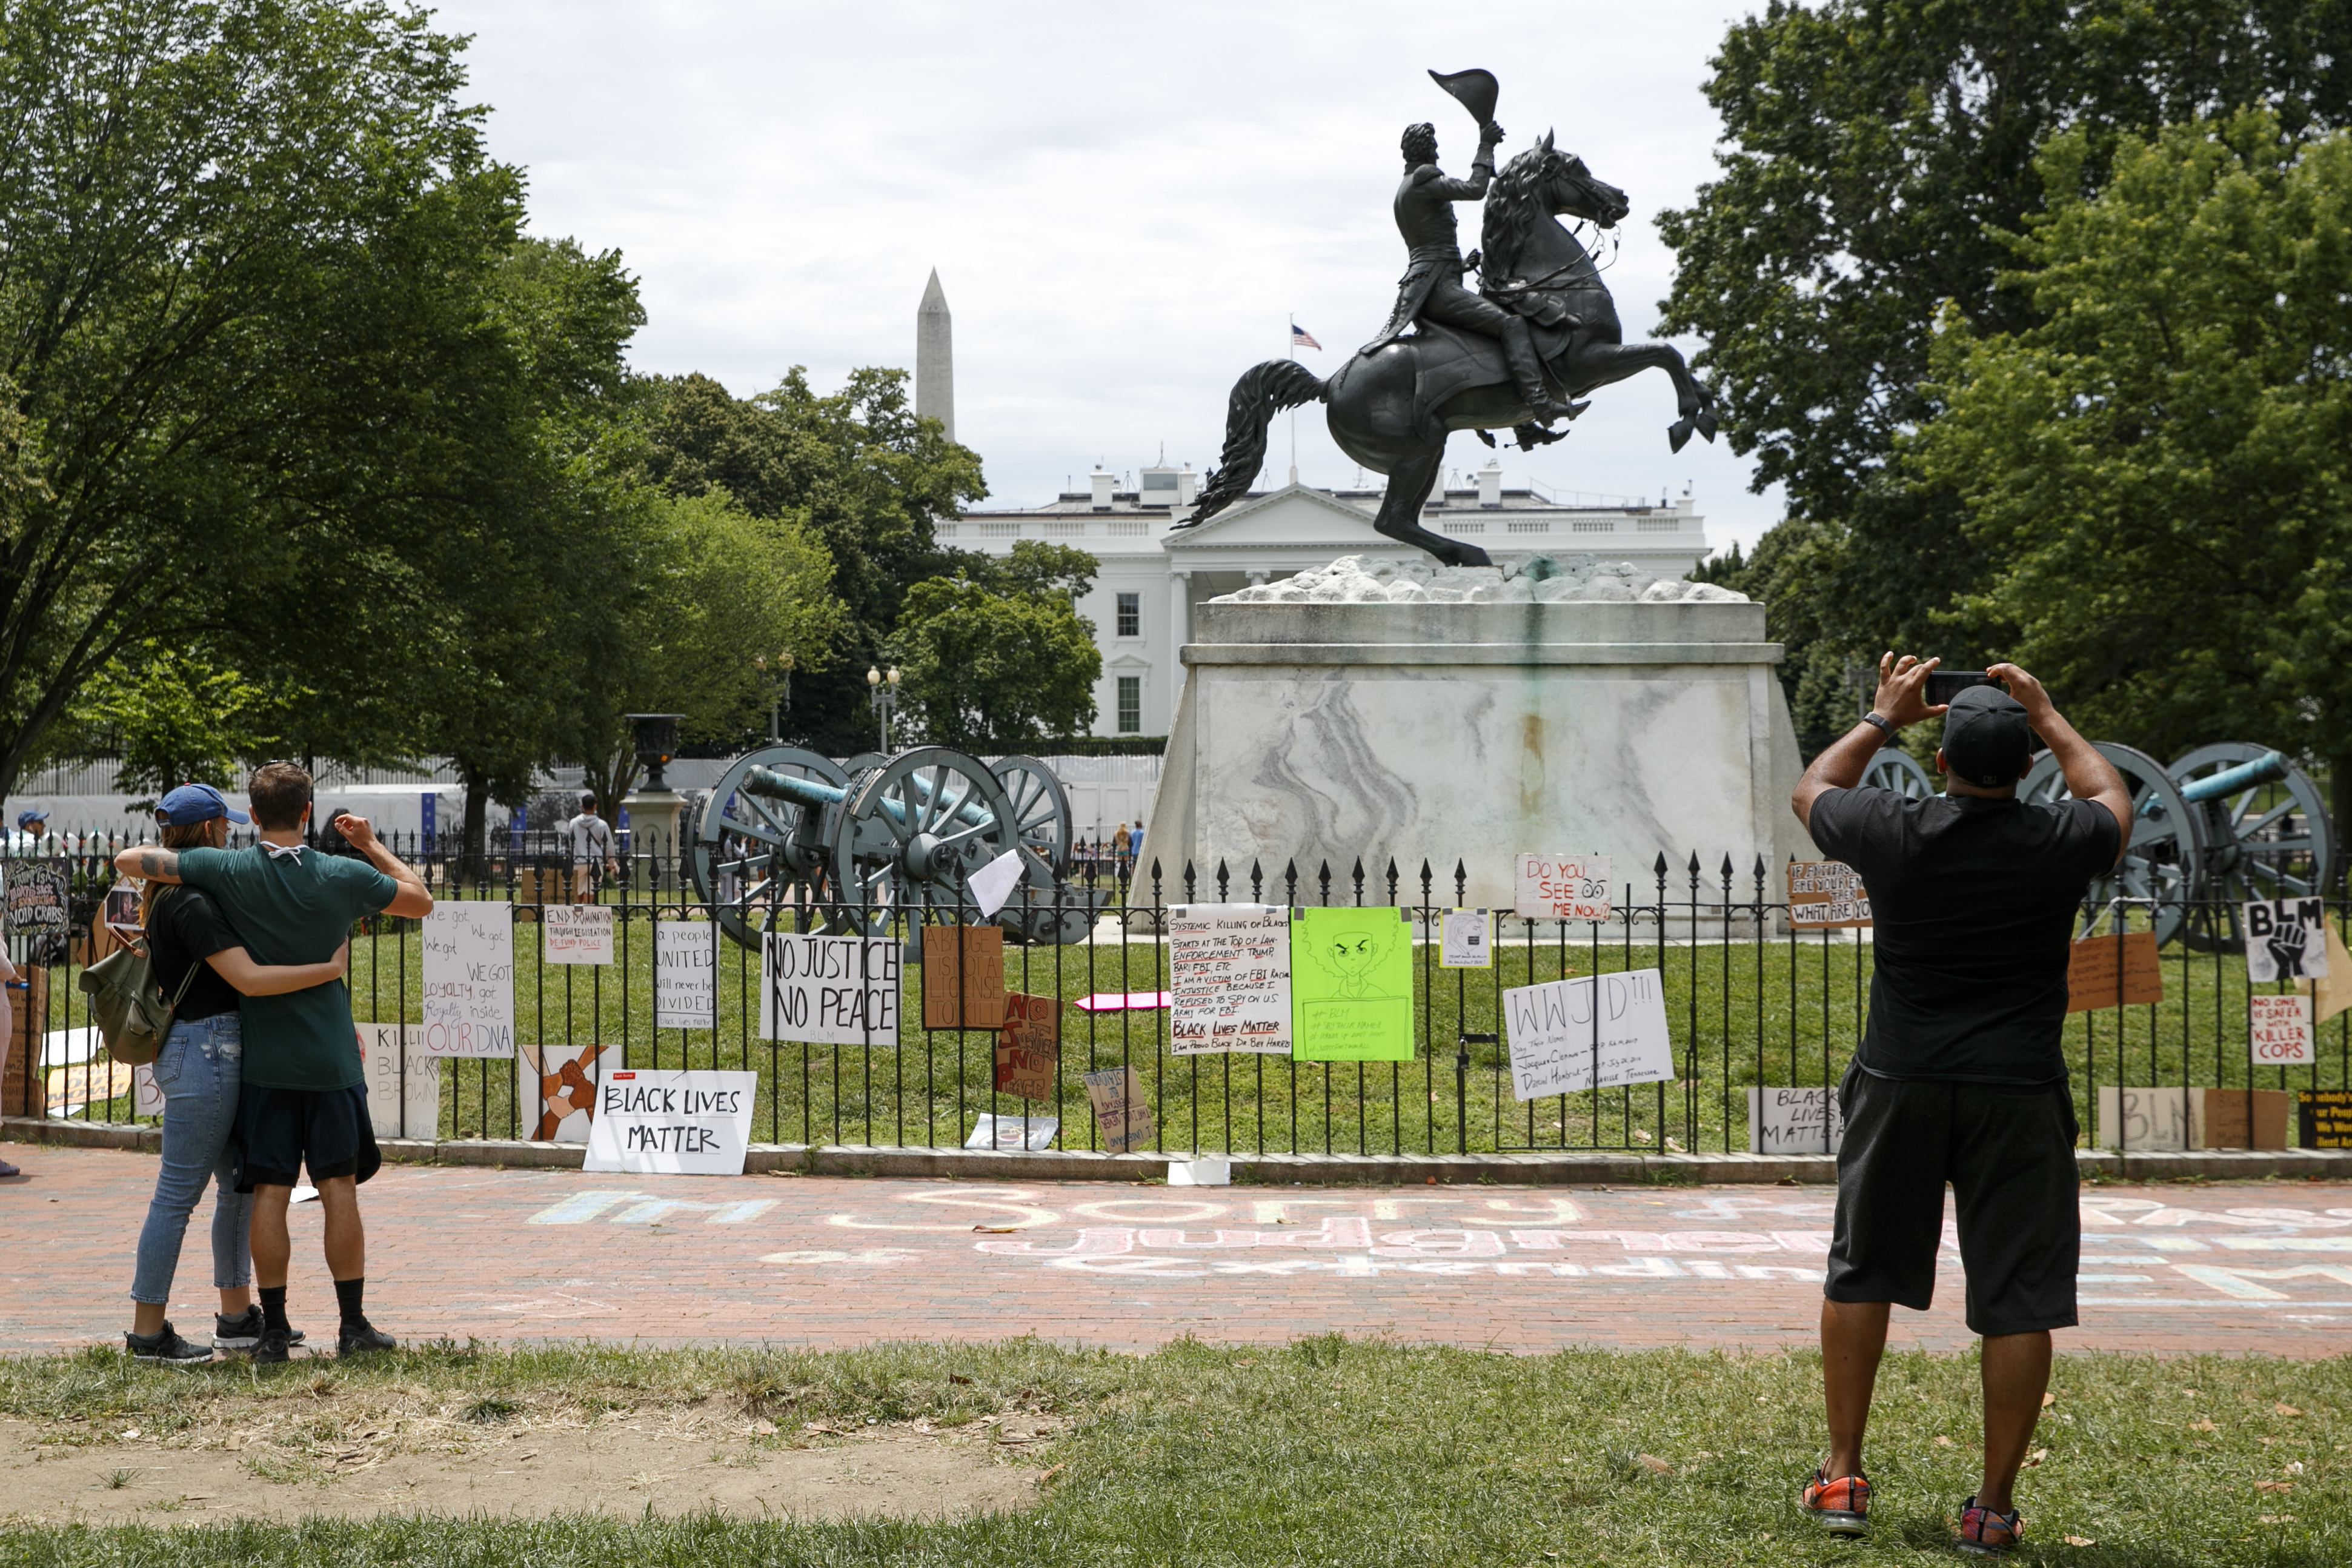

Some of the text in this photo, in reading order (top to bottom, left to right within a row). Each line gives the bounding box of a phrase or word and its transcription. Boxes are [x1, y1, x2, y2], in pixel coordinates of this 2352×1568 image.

[1528, 861, 1585, 879] DO YOU
[1792, 866, 1801, 877] IF
[36, 884, 53, 895] SACK
[1539, 882, 1573, 899] SEE
[1794, 878, 1845, 891] ARE YOUR
[1831, 891, 1856, 901] THEN
[10, 905, 63, 925] VOID CRABS
[547, 909, 611, 925] END DOMINATION
[1553, 903, 1609, 919] ME NOW?
[1793, 901, 1869, 920] WHAT ARE YO
[2250, 899, 2323, 937] BLM
[574, 928, 611, 937] LEGISLATION
[1170, 919, 1211, 930] SYSTEMIC
[1217, 919, 1248, 929] KILLING
[471, 923, 505, 951] We got
[550, 937, 576, 946] DE-FUND
[657, 930, 711, 944] a people
[925, 928, 990, 952] A BADGE
[1172, 939, 1200, 948] STARTS
[1212, 938, 1227, 946] THE
[1229, 935, 1243, 947] TOP
[424, 935, 457, 961] We got
[656, 949, 713, 968] UNITED
[767, 937, 902, 980] NO JUSTICE
[938, 956, 950, 976] IS
[987, 956, 997, 977] A
[467, 962, 511, 982] WE GOT
[1173, 976, 1181, 985] I
[1249, 969, 1267, 980] FBI
[675, 982, 699, 991] never
[702, 978, 713, 991] be
[930, 976, 1001, 999] LICENSE
[1172, 985, 1220, 996] INJUSTICE
[1226, 982, 1265, 991] BECAUSE
[479, 985, 497, 1003] got
[1174, 997, 1213, 1006] REFUSED
[1216, 995, 1226, 1004] TO
[1227, 995, 1246, 1004] SPY
[2252, 997, 2295, 1006] NO ONE
[424, 1000, 503, 1029] Royalty inside
[776, 986, 895, 1031] NO PEACE
[931, 1001, 954, 1025] TO
[1006, 995, 1048, 1022] NO
[1173, 1009, 1194, 1018] ARMY
[660, 1016, 675, 1025] black
[679, 1017, 691, 1026] lives
[1173, 1020, 1206, 1037] BLACK
[1212, 1021, 1238, 1035] LIVES
[1357, 1020, 1382, 1029] NAMES
[428, 1023, 512, 1054] OUR DNA
[810, 1029, 834, 1041] BLM
[2253, 1027, 2307, 1043] KILLER
[1189, 1040, 1209, 1049] PROUD
[1511, 1041, 1526, 1057] Say
[2259, 1043, 2304, 1059] COPS
[378, 1055, 434, 1081] BLACK
[1009, 1050, 1045, 1074] NO
[997, 1063, 1045, 1101] PEACE
[378, 1081, 436, 1103] BROWN
[605, 1085, 740, 1114] BLACK LIVES
[1108, 1089, 1119, 1098] BUT
[1777, 1090, 1838, 1106] BLACK
[1101, 1117, 1121, 1129] NEVER
[1791, 1108, 1836, 1122] LIVES
[628, 1125, 720, 1152] MATTER
[826, 1188, 1583, 1229] Sorry
